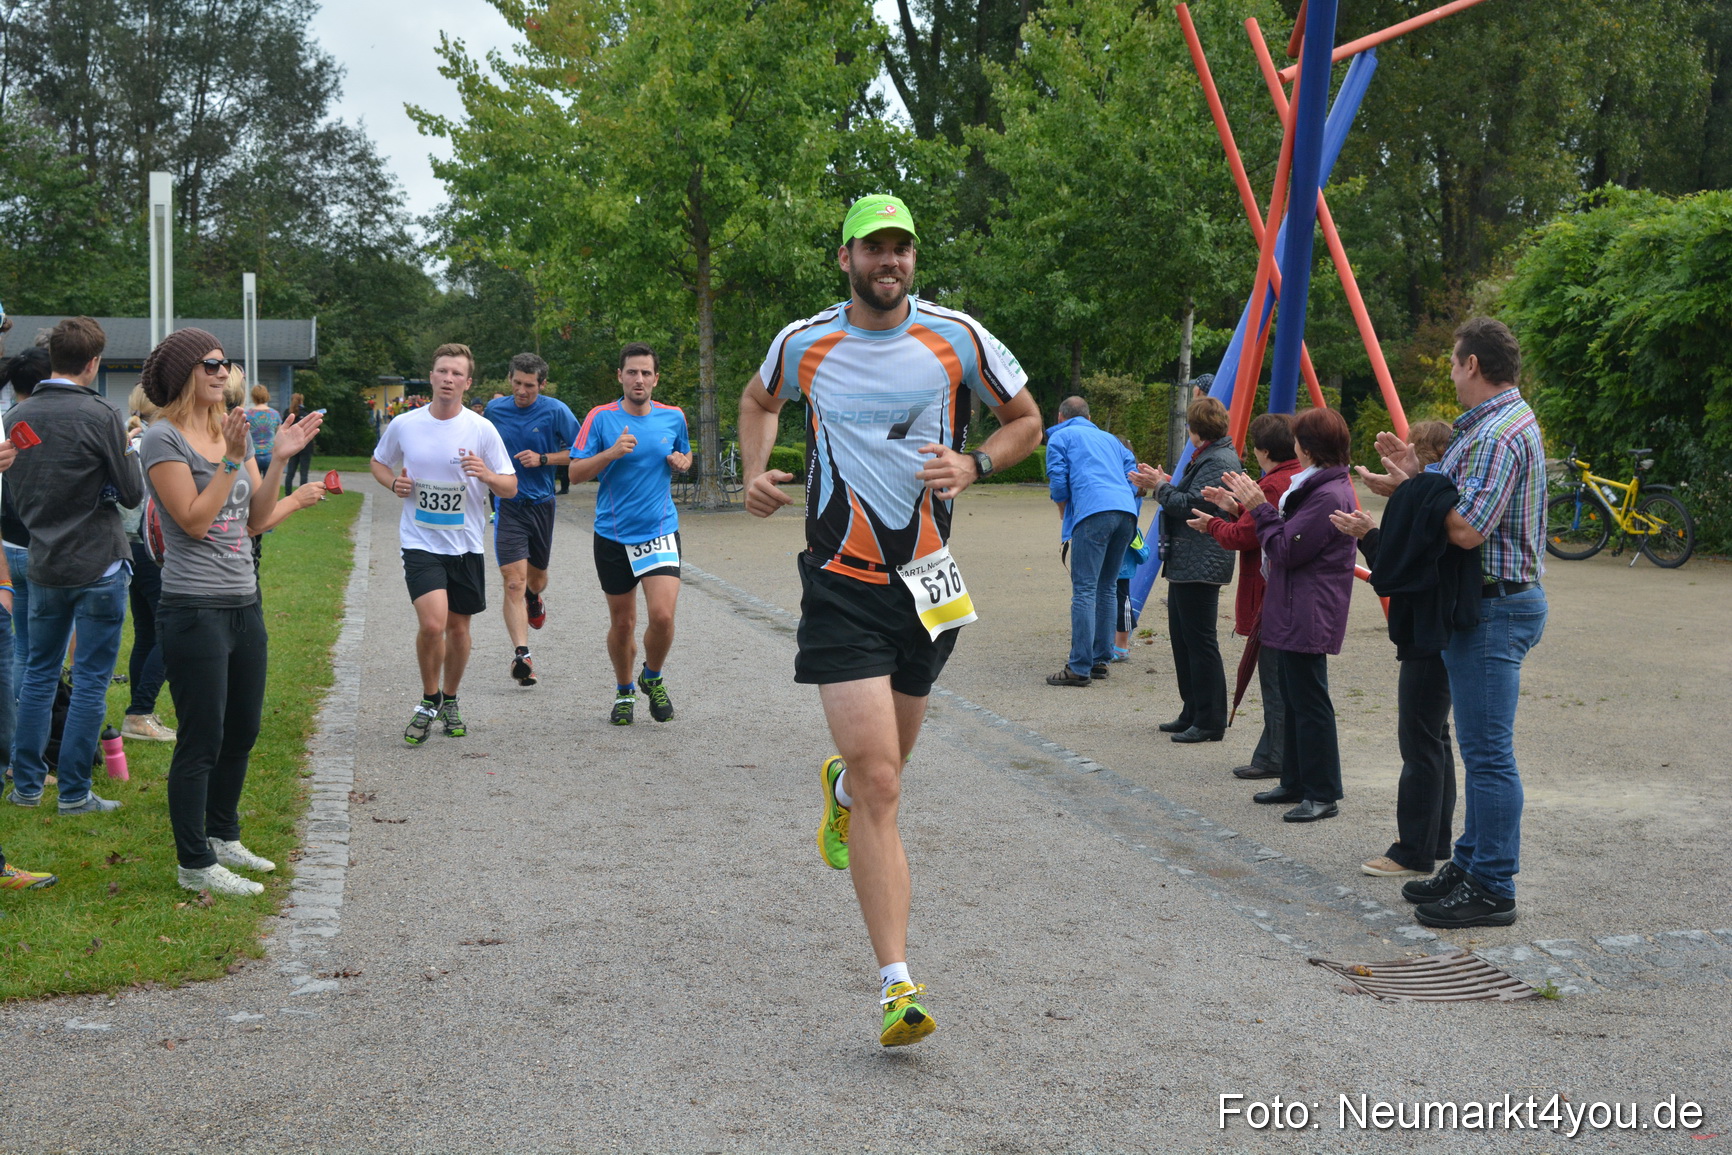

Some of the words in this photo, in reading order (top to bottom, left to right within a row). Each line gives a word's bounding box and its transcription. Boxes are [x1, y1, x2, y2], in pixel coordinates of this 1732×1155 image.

[826, 409, 909, 424] SPEED
[415, 482, 432, 490] PARTL
[419, 490, 462, 512] 3332
[633, 535, 671, 558] 3391
[900, 566, 926, 579] PARTL
[920, 561, 962, 604] 616
